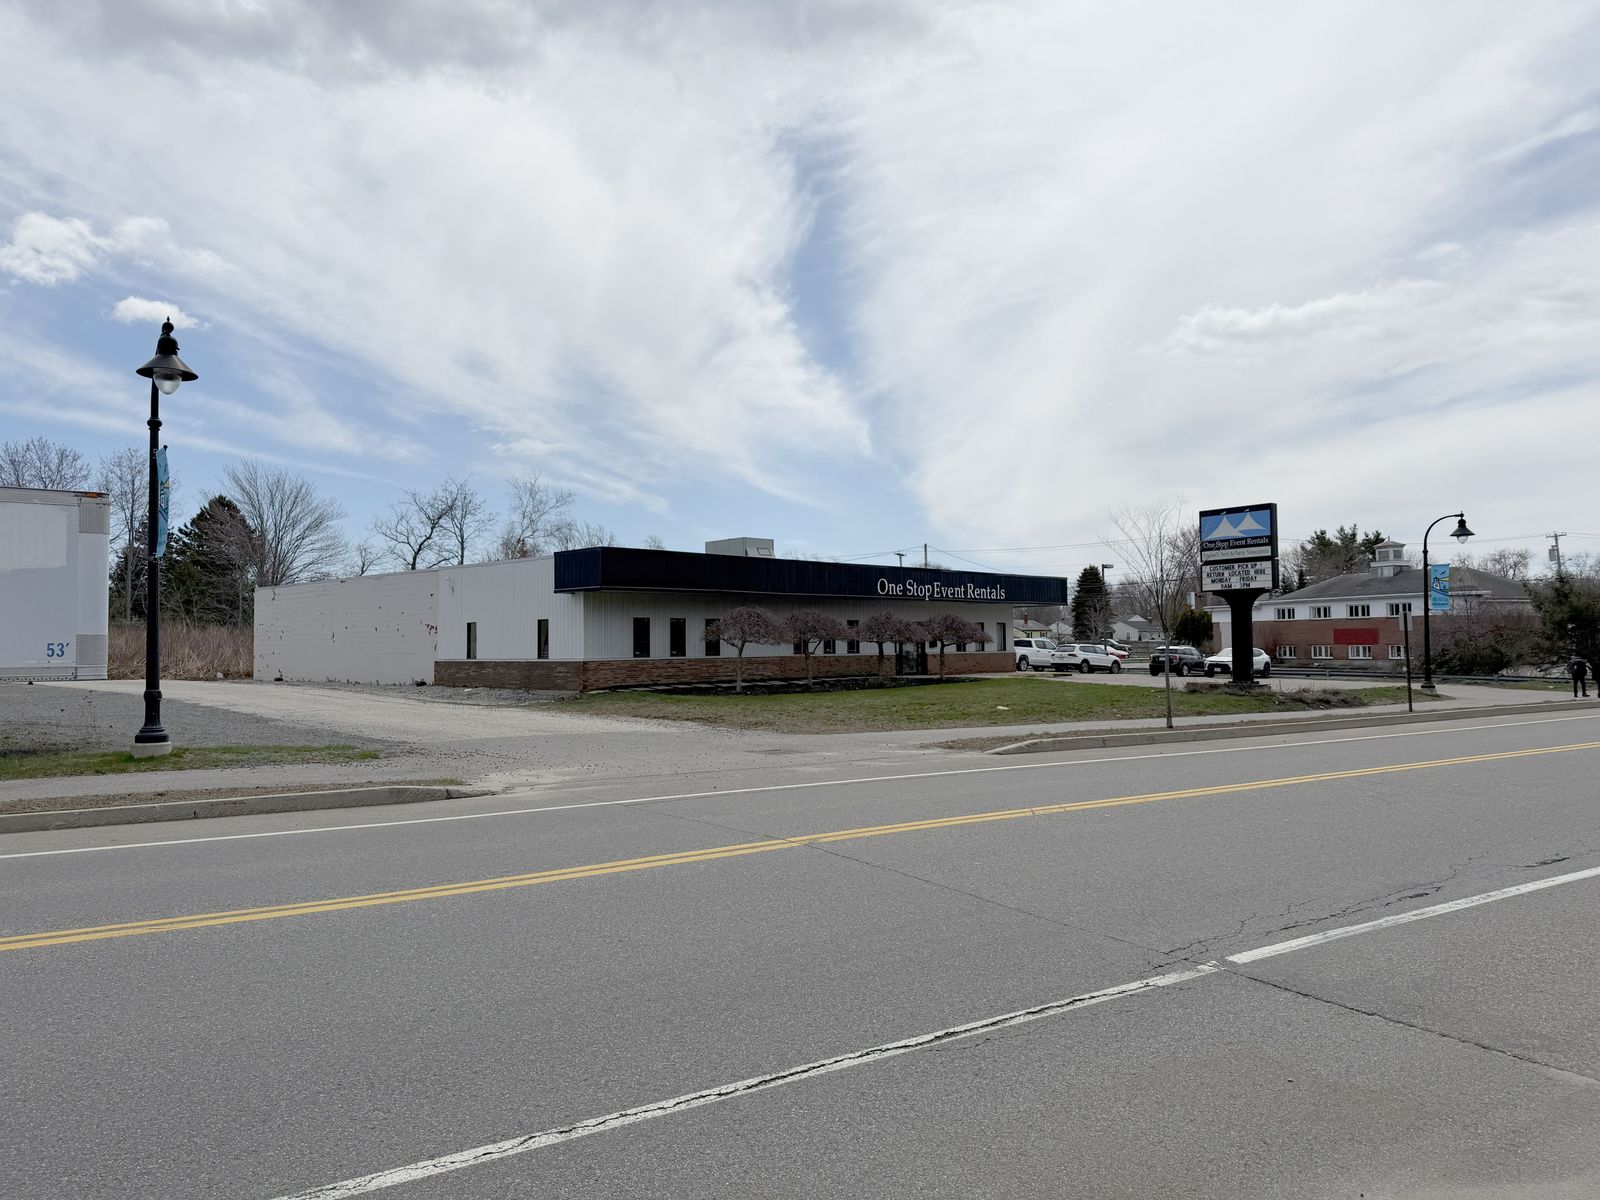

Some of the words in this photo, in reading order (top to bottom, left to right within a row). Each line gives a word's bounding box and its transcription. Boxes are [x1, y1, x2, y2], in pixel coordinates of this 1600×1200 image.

[1216, 541, 1229, 549] Stop
[1247, 536, 1269, 545] Rentals
[877, 578, 903, 595] One
[906, 579, 932, 600] Stop
[933, 582, 965, 598] Event
[967, 583, 1006, 600] Rentals
